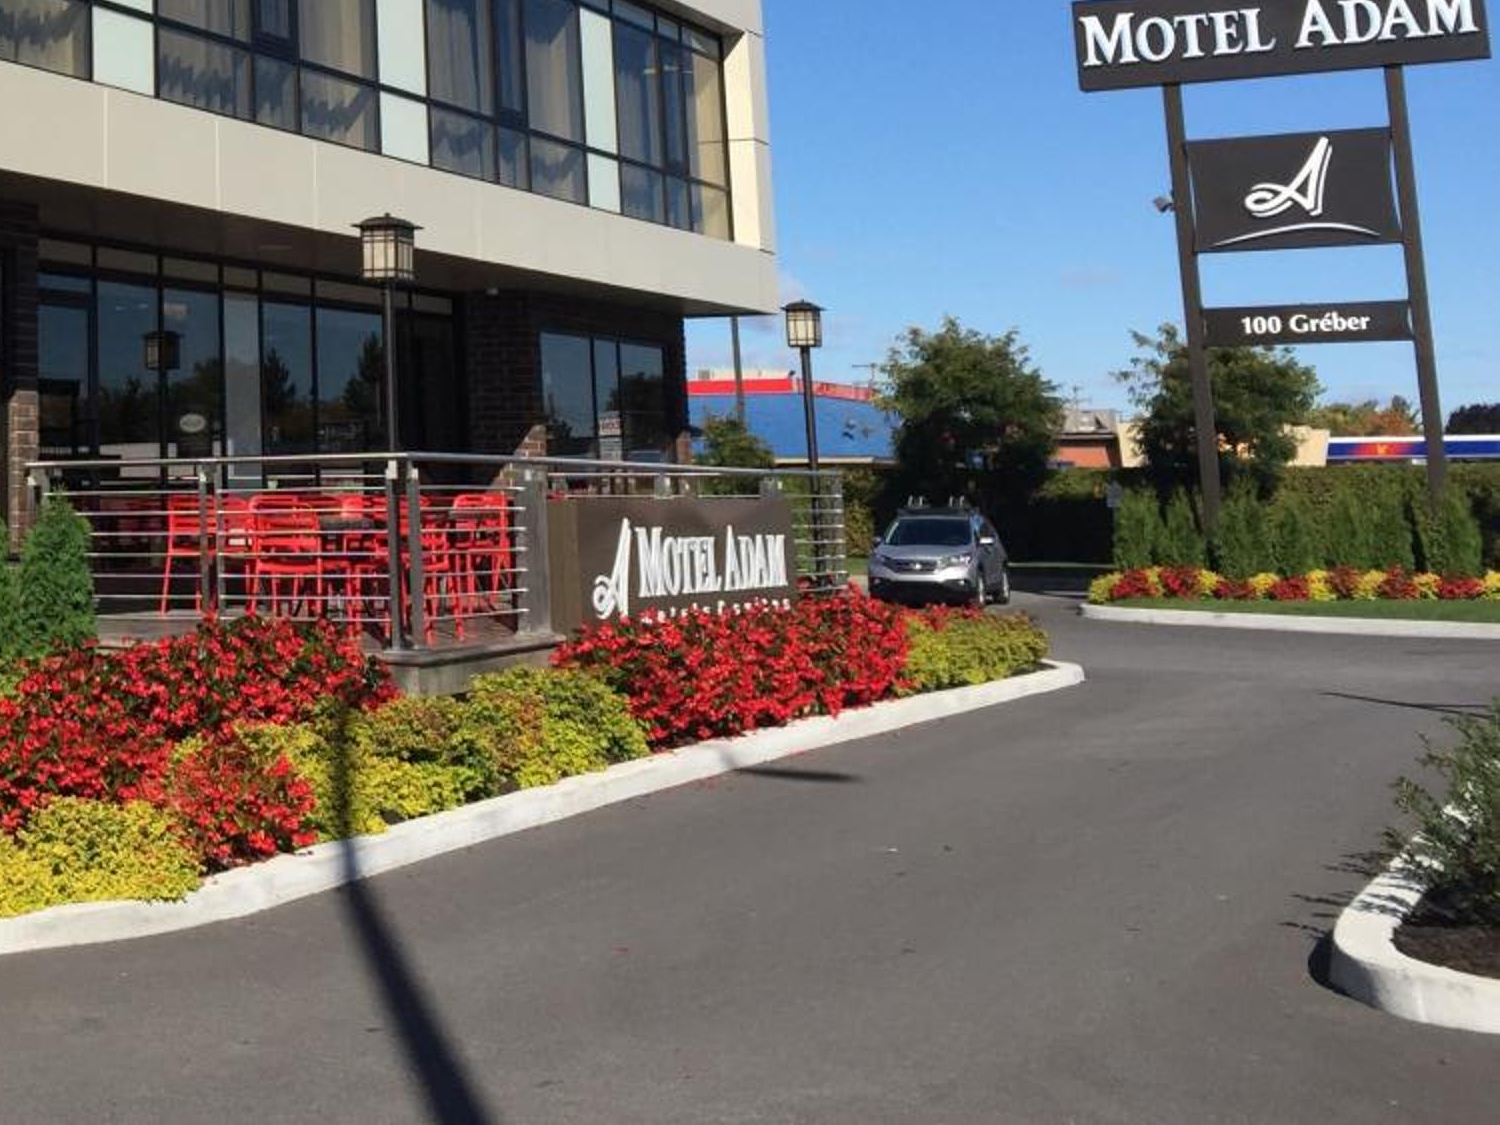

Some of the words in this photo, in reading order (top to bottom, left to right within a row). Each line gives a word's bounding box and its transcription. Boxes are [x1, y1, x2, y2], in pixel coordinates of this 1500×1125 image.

[1078, 7, 1277, 68] MOTEL
[1241, 315, 1283, 335] 100
[1288, 310, 1371, 334] Gréber
[634, 526, 723, 598] MOTEL
[723, 524, 790, 592] ADAM
